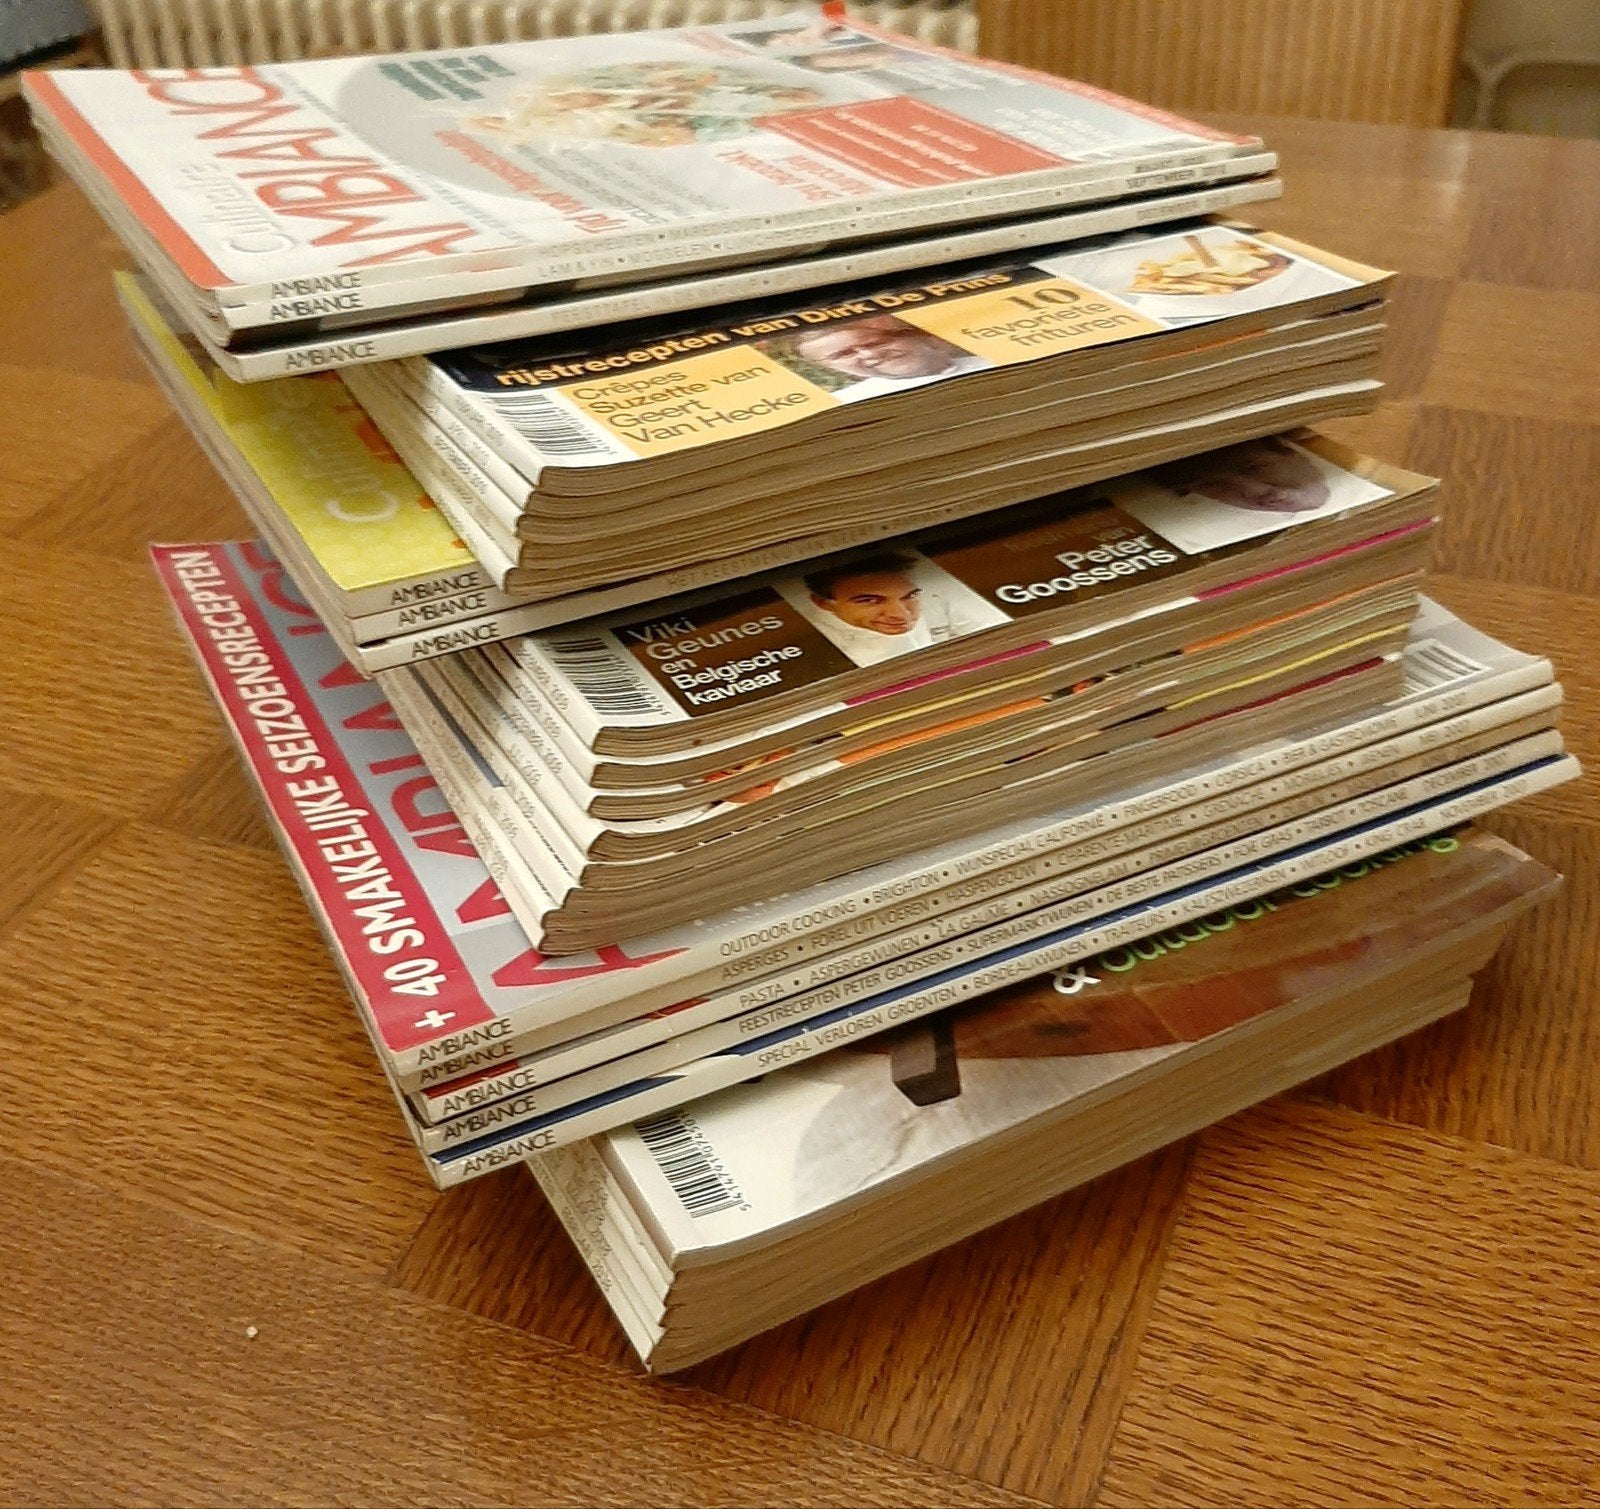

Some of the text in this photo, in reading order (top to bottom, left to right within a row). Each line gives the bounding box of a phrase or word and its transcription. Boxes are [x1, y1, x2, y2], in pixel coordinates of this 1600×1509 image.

[270, 272, 361, 299] AMBIANCE
[1001, 287, 1081, 311] 10
[269, 293, 361, 319] AMBIANCE
[961, 301, 1113, 340] favoriete
[496, 272, 1013, 386] rijstrecepten van Dirk De Prins
[1008, 310, 1139, 346] frituren
[286, 341, 376, 369] AMBIANCE
[572, 370, 690, 401] Crêpes
[588, 364, 771, 415] Suzette van
[606, 399, 712, 430] Geert
[619, 420, 700, 445] Van
[698, 390, 811, 428] Hecke
[1055, 535, 1154, 570] Peter
[391, 571, 479, 605] AMBIANCE
[995, 549, 1178, 604] Goossens
[398, 592, 487, 627] AMBIANCE
[412, 622, 500, 658] AMBIANCE
[628, 616, 698, 645] Viki
[646, 614, 784, 661] Geunes
[170, 551, 327, 774] SEIZOENSRECEPTEN
[660, 656, 698, 675] en
[671, 643, 804, 690] Belgische
[683, 667, 784, 707] kaviaar
[286, 774, 426, 955] SMAKELIJKE
[382, 957, 450, 998] 40
[417, 1017, 513, 1065] AMBIANCE
[720, 923, 789, 956] OUTDOOR
[793, 900, 856, 931] COOKING
[873, 871, 939, 903] BRIGHTON
[419, 1041, 514, 1084] AMBIANCE
[722, 947, 788, 979] ASPERGES
[811, 926, 852, 949] FOREL
[443, 1095, 537, 1141] AMBIANCE
[739, 985, 840, 1033] FEESTRECEPTEN
[844, 972, 881, 995] PETER
[885, 946, 953, 981] GOOSSENS
[1106, 886, 1121, 902] DE
[443, 1069, 537, 1115] AMBIANCE
[739, 982, 784, 1007] PASTA
[462, 1129, 557, 1176] AMBIANCE
[758, 1037, 811, 1067] SPECIAL
[815, 1011, 882, 1046] VERLOREN
[887, 985, 957, 1020] GROENTEN
